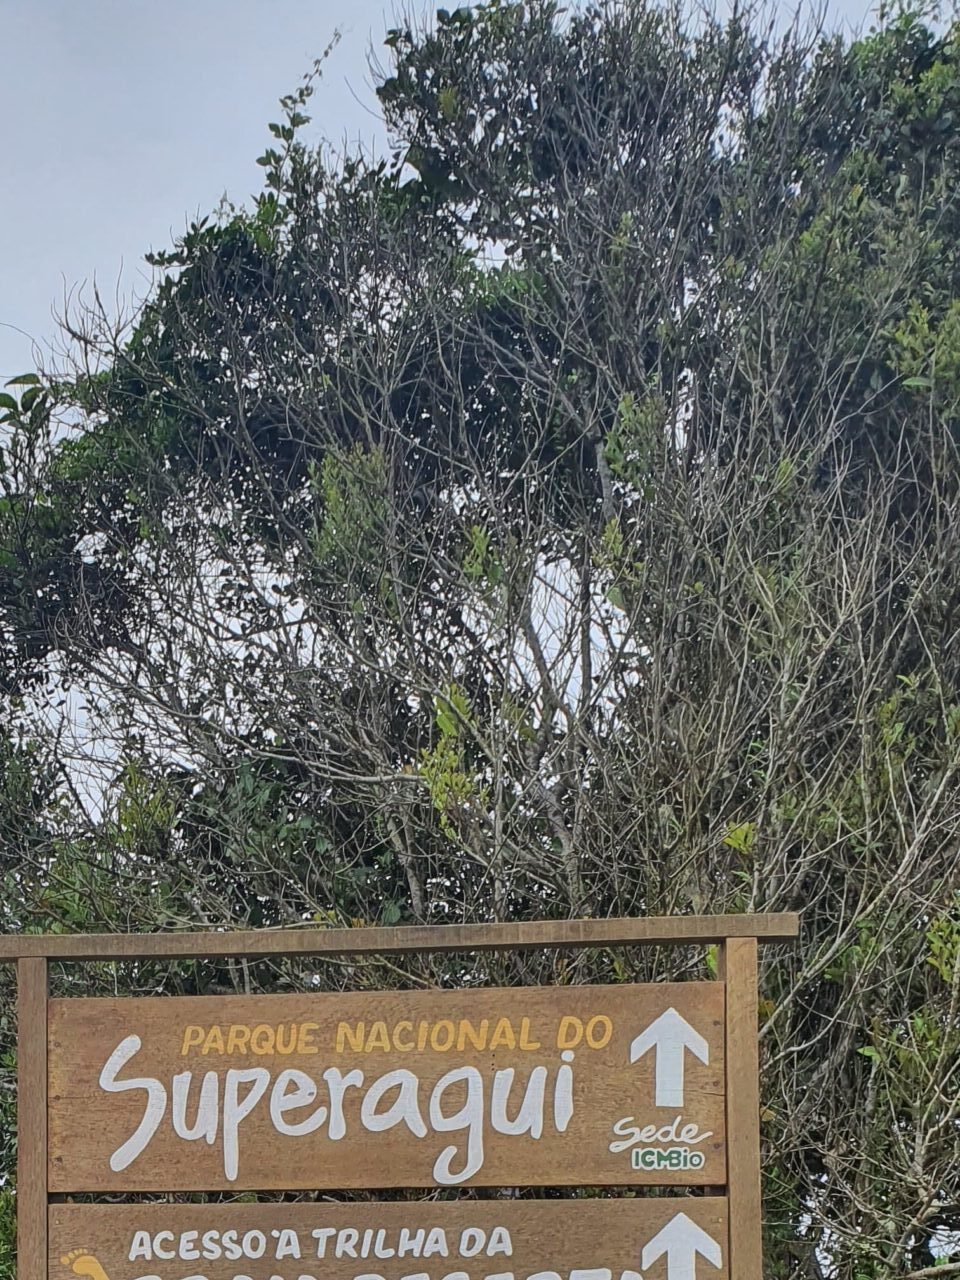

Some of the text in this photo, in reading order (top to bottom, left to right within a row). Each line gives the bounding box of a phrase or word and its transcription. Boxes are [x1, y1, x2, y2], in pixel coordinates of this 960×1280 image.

[181, 1015, 614, 1056] PARQUE NACIONAL DO
[99, 1034, 574, 1185] Superagui
[609, 1115, 713, 1153] Sede
[632, 1147, 705, 1170] ICMBio
[128, 1229, 266, 1261] ACESSO
[312, 1227, 449, 1258] TRILHA
[458, 1226, 513, 1257] DA
